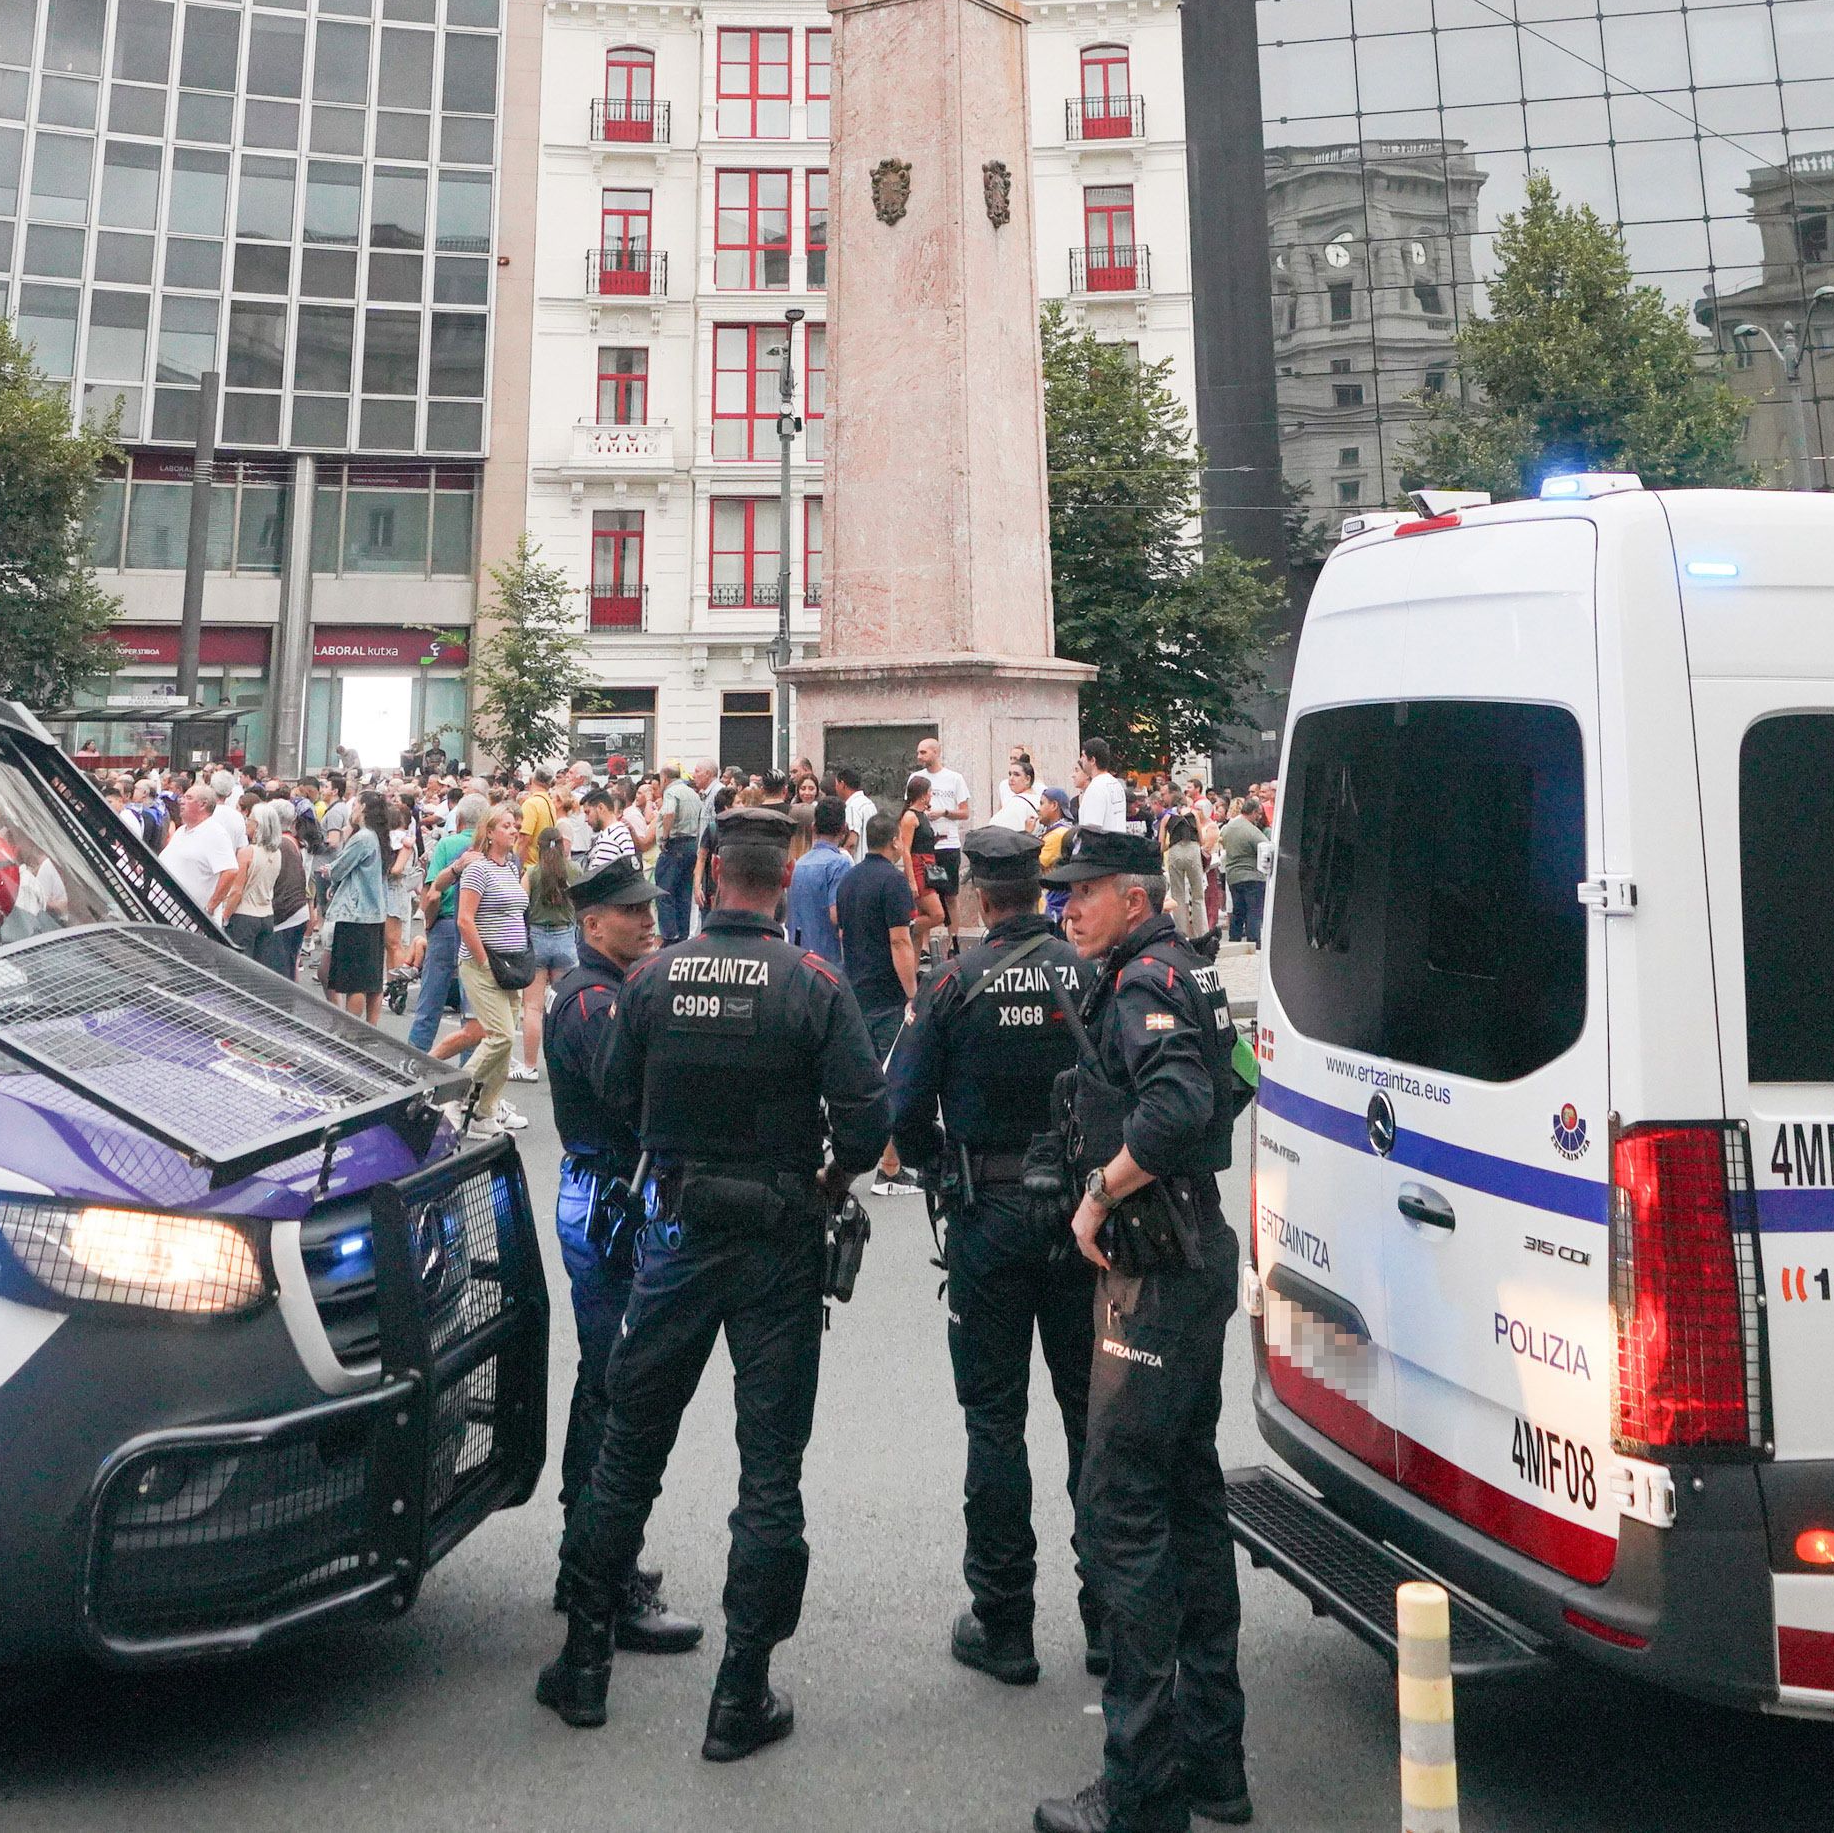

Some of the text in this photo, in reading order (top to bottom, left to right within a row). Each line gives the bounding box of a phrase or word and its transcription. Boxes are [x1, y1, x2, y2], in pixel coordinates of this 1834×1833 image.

[313, 645, 399, 656] LABORAL kutxa
[668, 957, 769, 986] ERTZAINTZA
[672, 995, 720, 1018] C9D9
[998, 1006, 1044, 1026] X9G8
[1325, 1056, 1452, 1105] www.ertzaintza.eus
[1261, 1205, 1331, 1273] ERTZAINTZA
[1523, 1235, 1556, 1257] 315
[1102, 1338, 1164, 1368] ERTZAINTZA
[1494, 1312, 1592, 1381] POLIZIA
[1511, 1416, 1597, 1512] 4MF08
